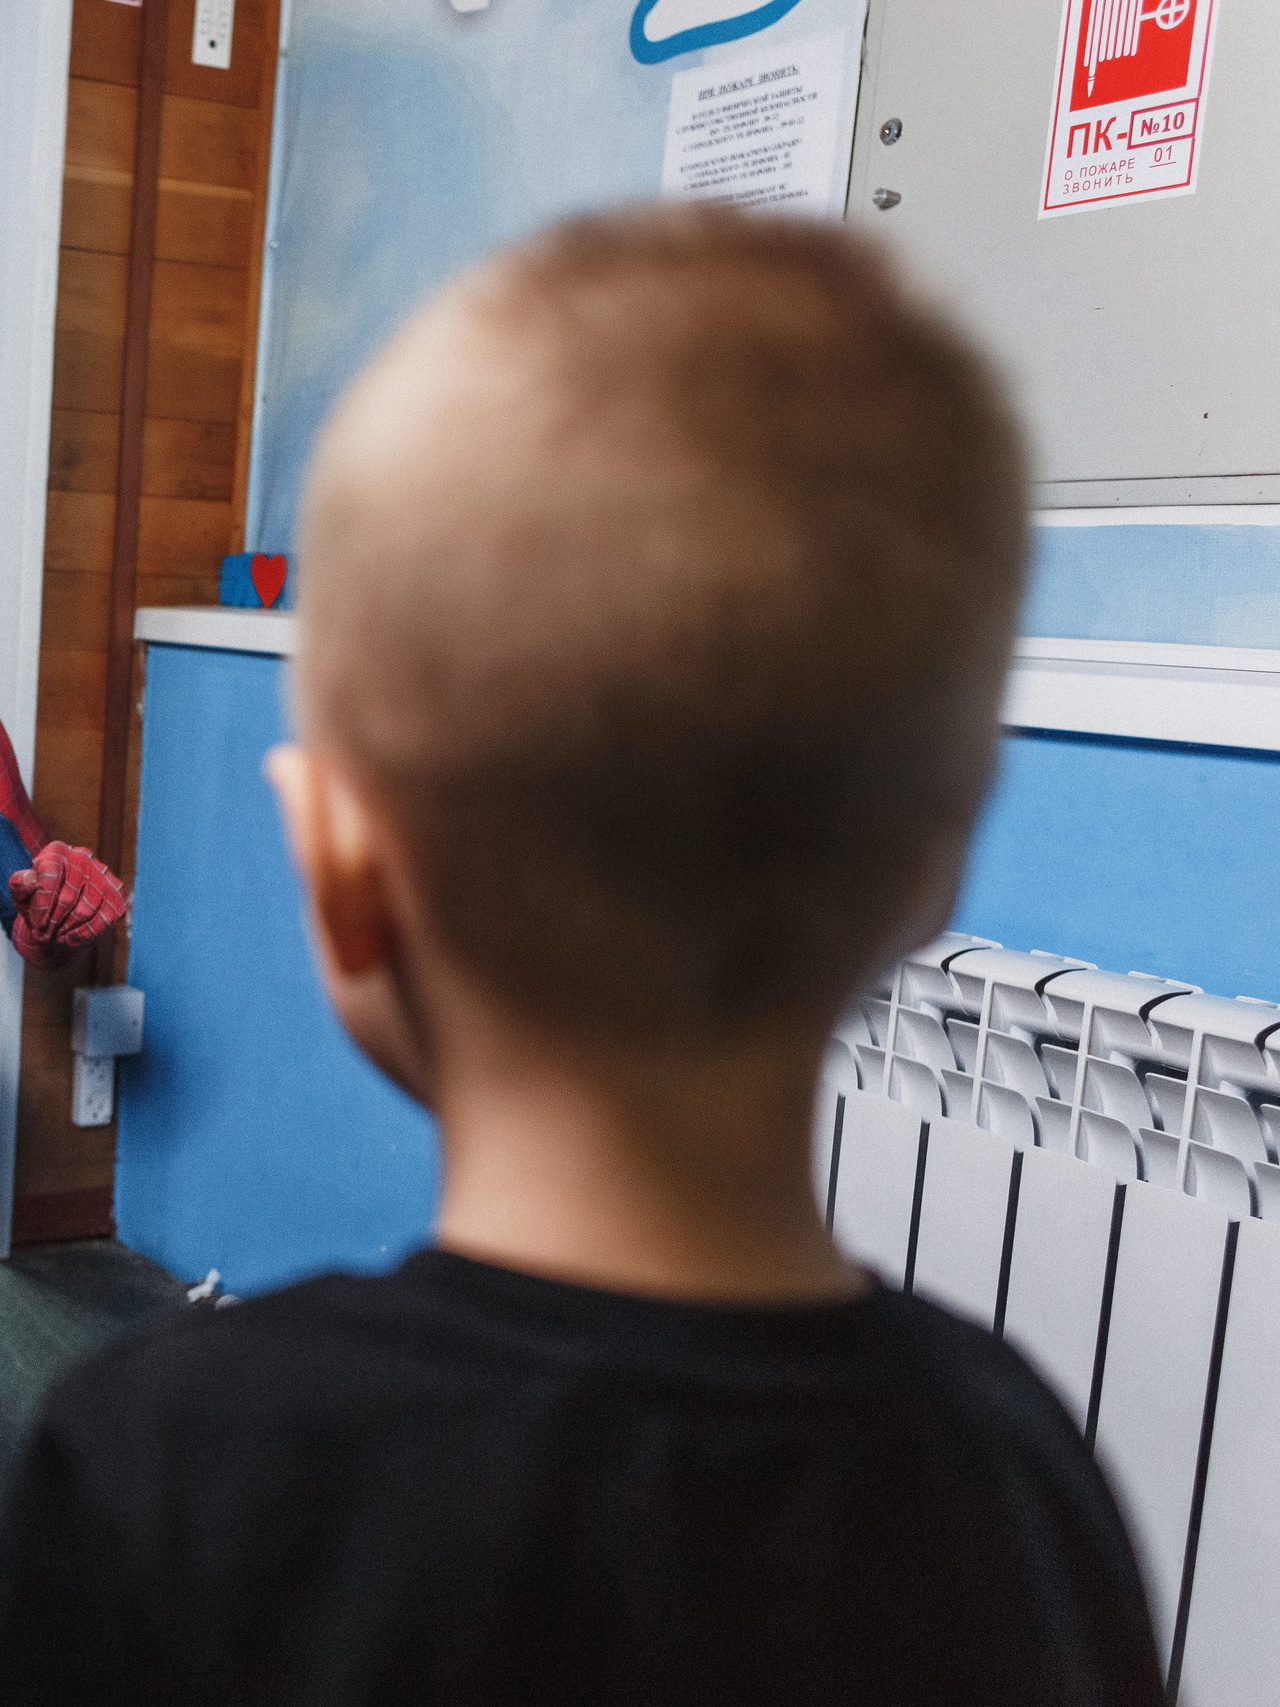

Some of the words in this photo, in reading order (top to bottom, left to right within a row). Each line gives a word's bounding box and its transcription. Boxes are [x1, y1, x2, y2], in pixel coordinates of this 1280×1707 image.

[1140, 111, 1185, 137] №10
[1064, 169, 1074, 181] О
[1079, 158, 1136, 179] ПОЖАРЕ
[1153, 145, 1173, 163] 01
[1062, 173, 1134, 195] ЗВОНИТЬ
